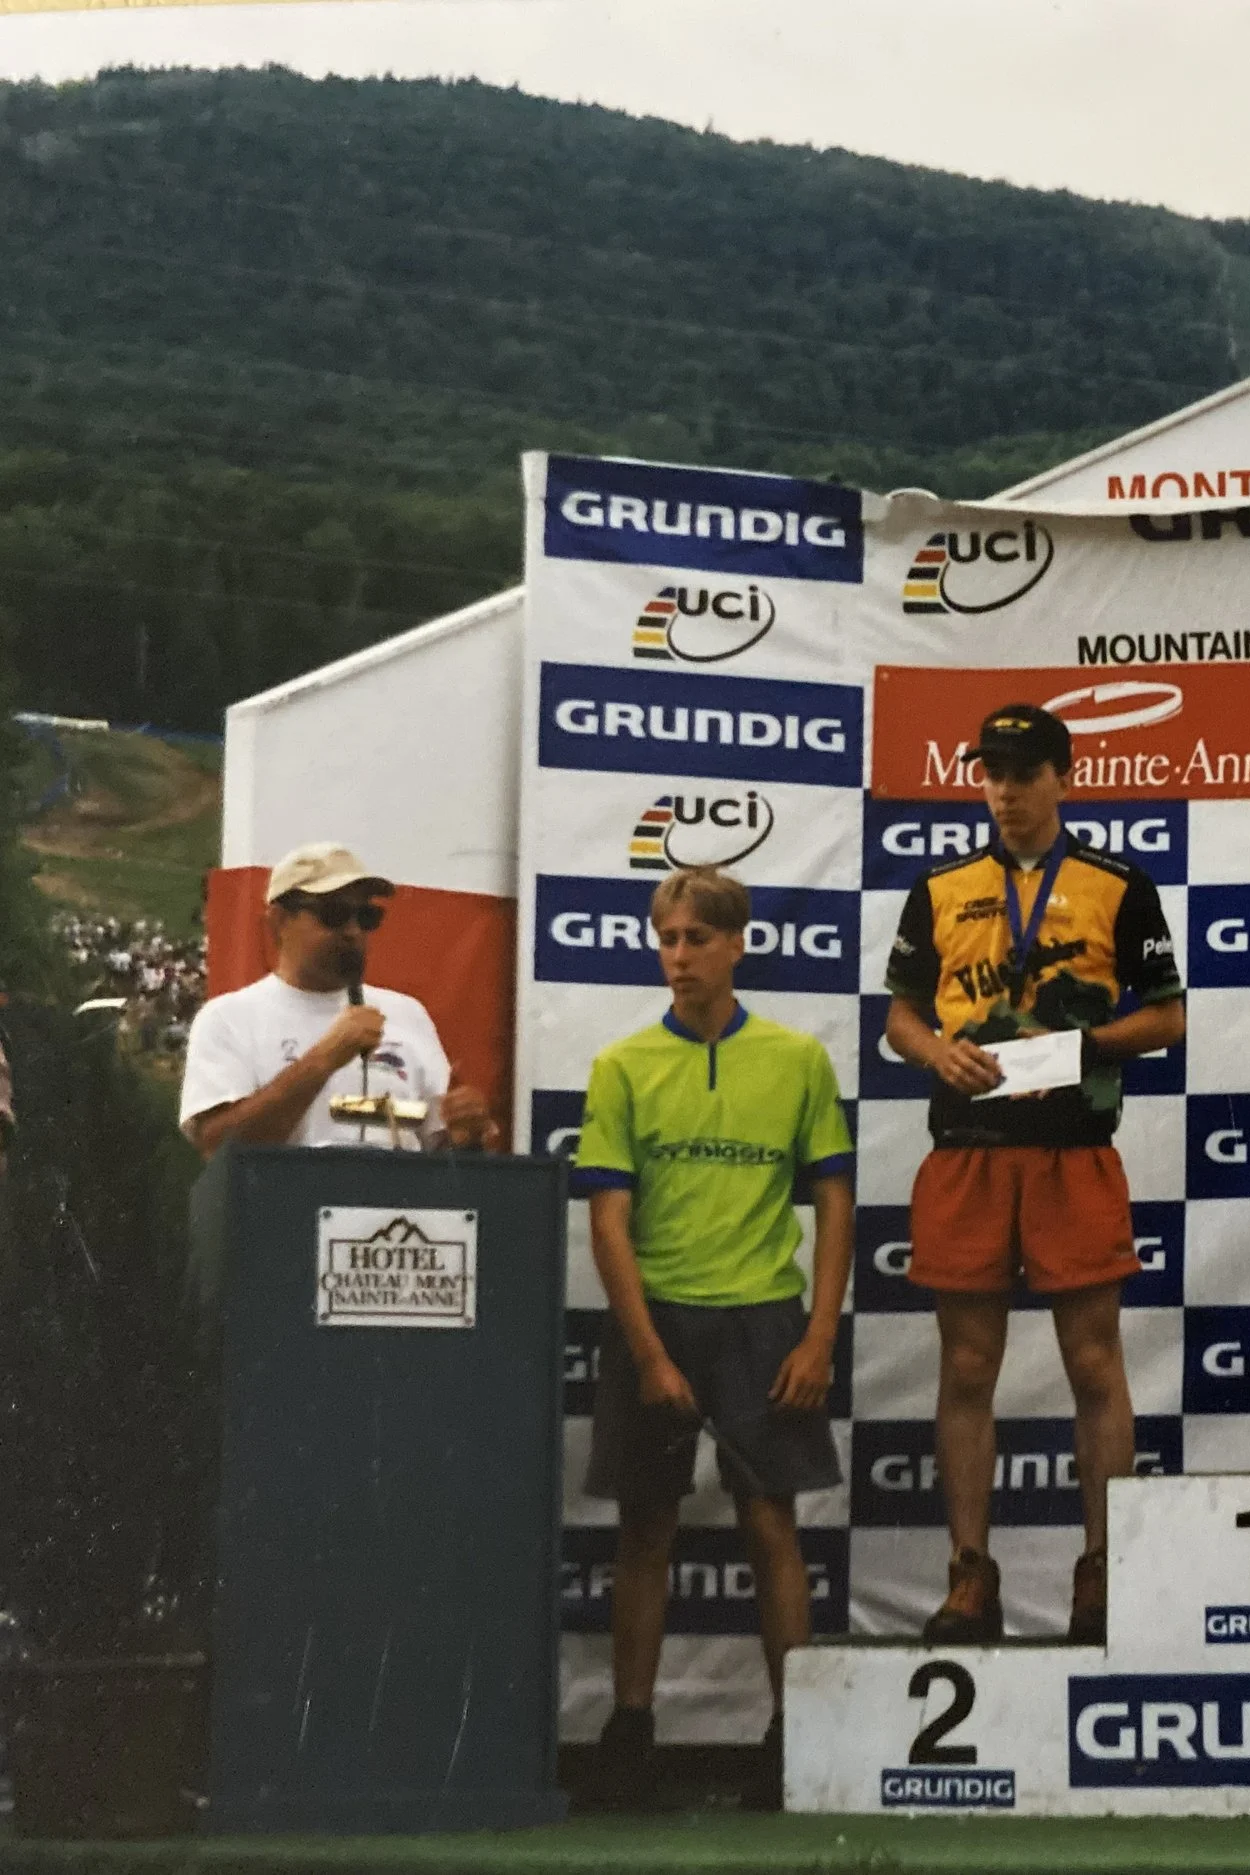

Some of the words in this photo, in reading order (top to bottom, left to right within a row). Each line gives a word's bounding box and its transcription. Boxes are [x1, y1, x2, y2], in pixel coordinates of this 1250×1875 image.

[561, 491, 846, 547] GRUNDIG
[555, 700, 846, 753] GRUNDIG
[350, 1248, 445, 1270] HOTEL
[908, 1660, 978, 1766] 2
[884, 1774, 1013, 1801] GRUNDIG
